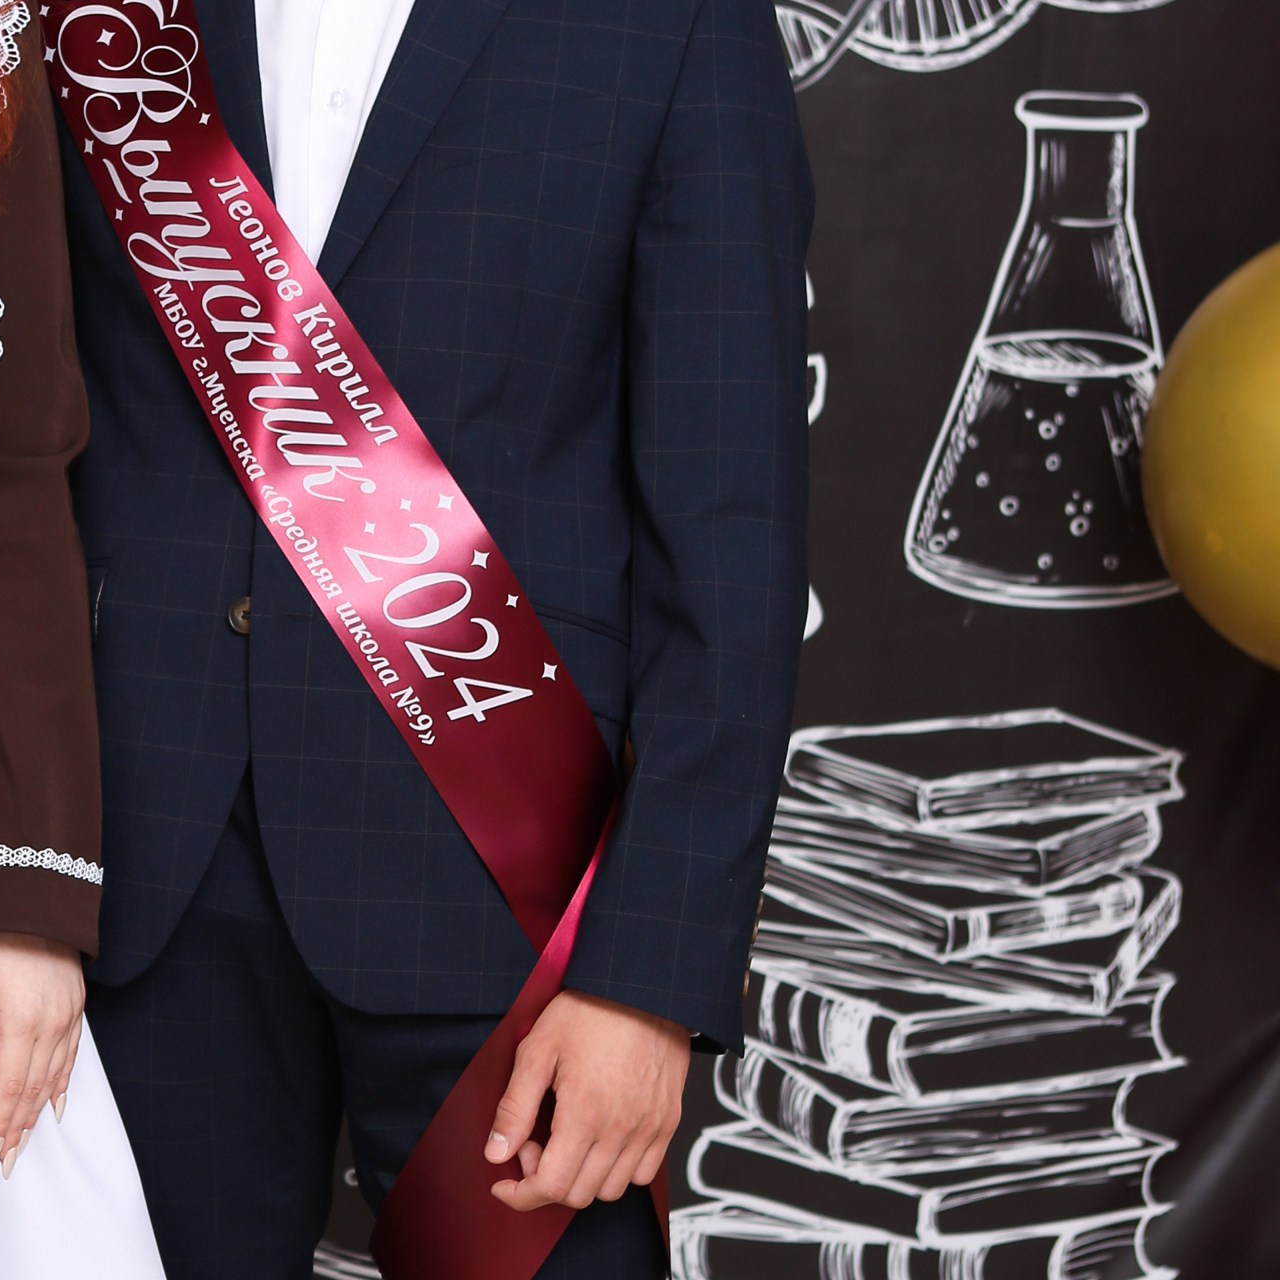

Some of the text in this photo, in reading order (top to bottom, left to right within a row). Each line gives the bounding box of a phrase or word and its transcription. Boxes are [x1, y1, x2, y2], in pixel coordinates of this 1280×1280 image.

[208, 175, 399, 447] Леонов Кирилл
[153, 281, 436, 746] МБОУ г.Мценска «Средняя школа №9»
[342, 522, 534, 723] 2024
